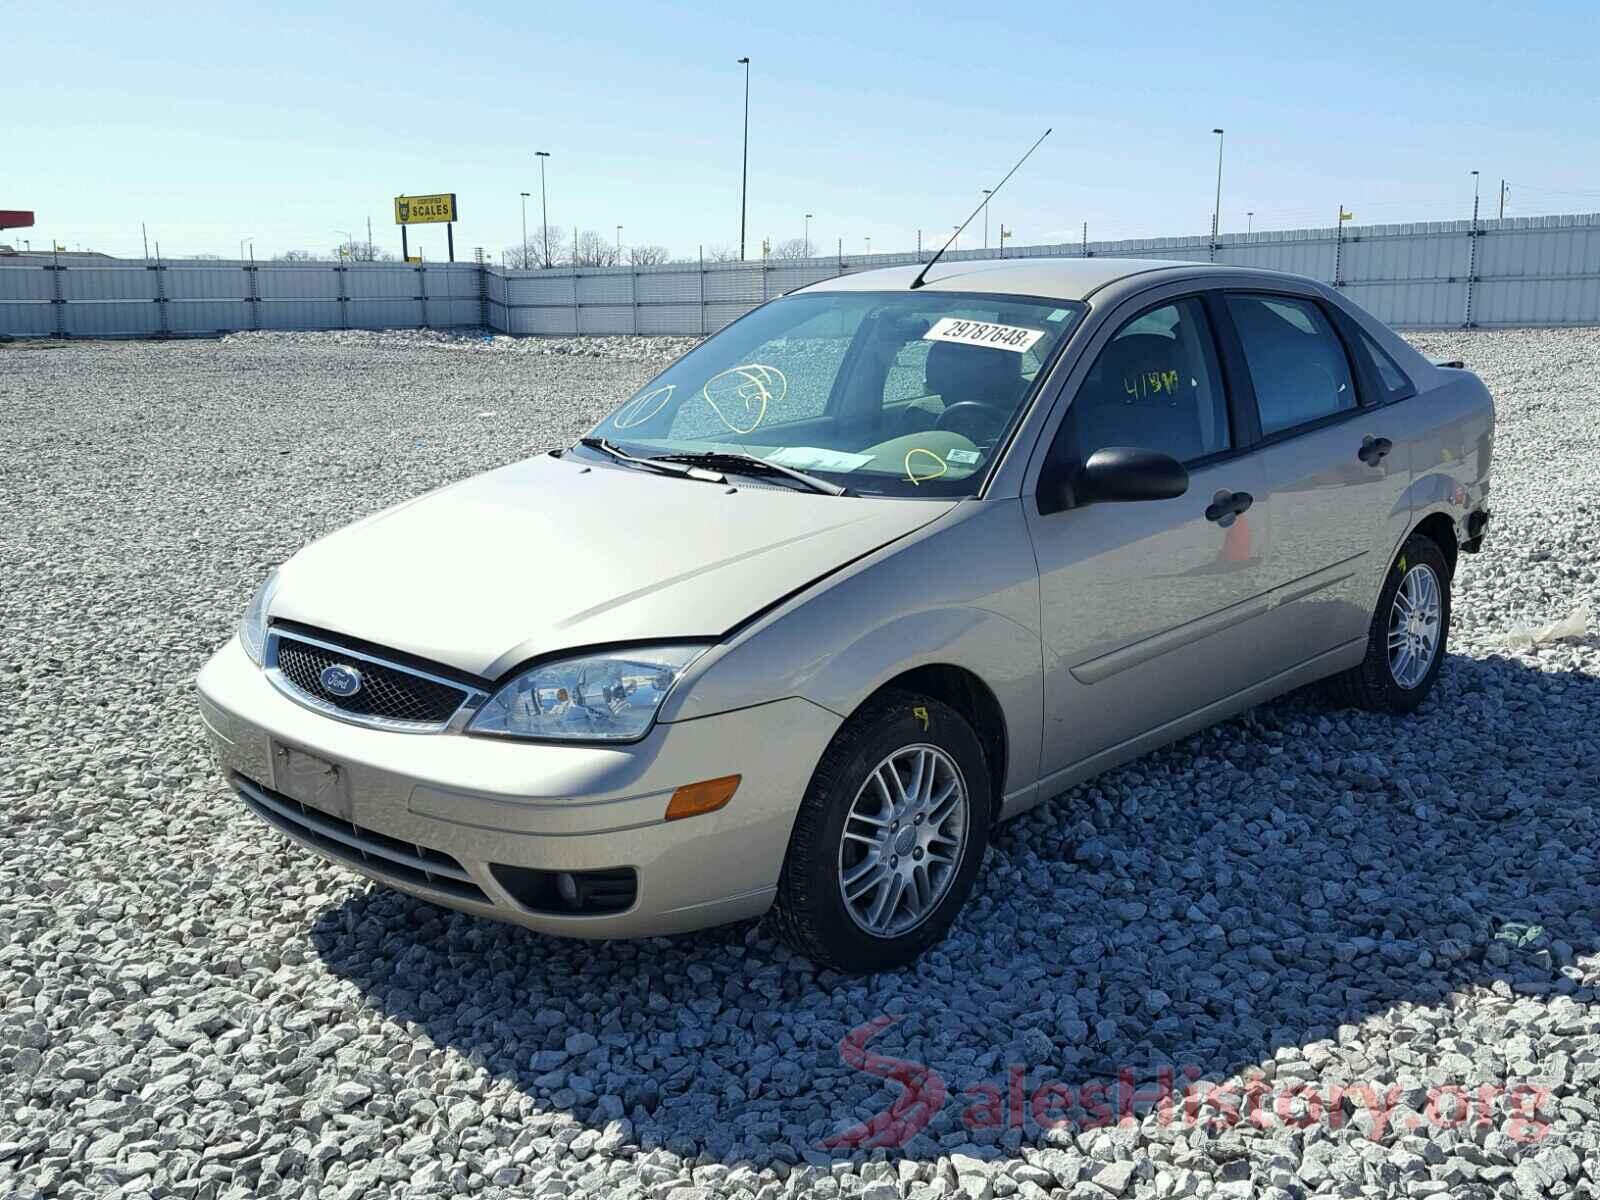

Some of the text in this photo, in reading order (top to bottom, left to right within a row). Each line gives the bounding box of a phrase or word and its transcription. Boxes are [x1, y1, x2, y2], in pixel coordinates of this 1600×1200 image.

[412, 204, 449, 217] SCALES
[942, 320, 1028, 346] 29787648
[327, 671, 350, 689] Ford
